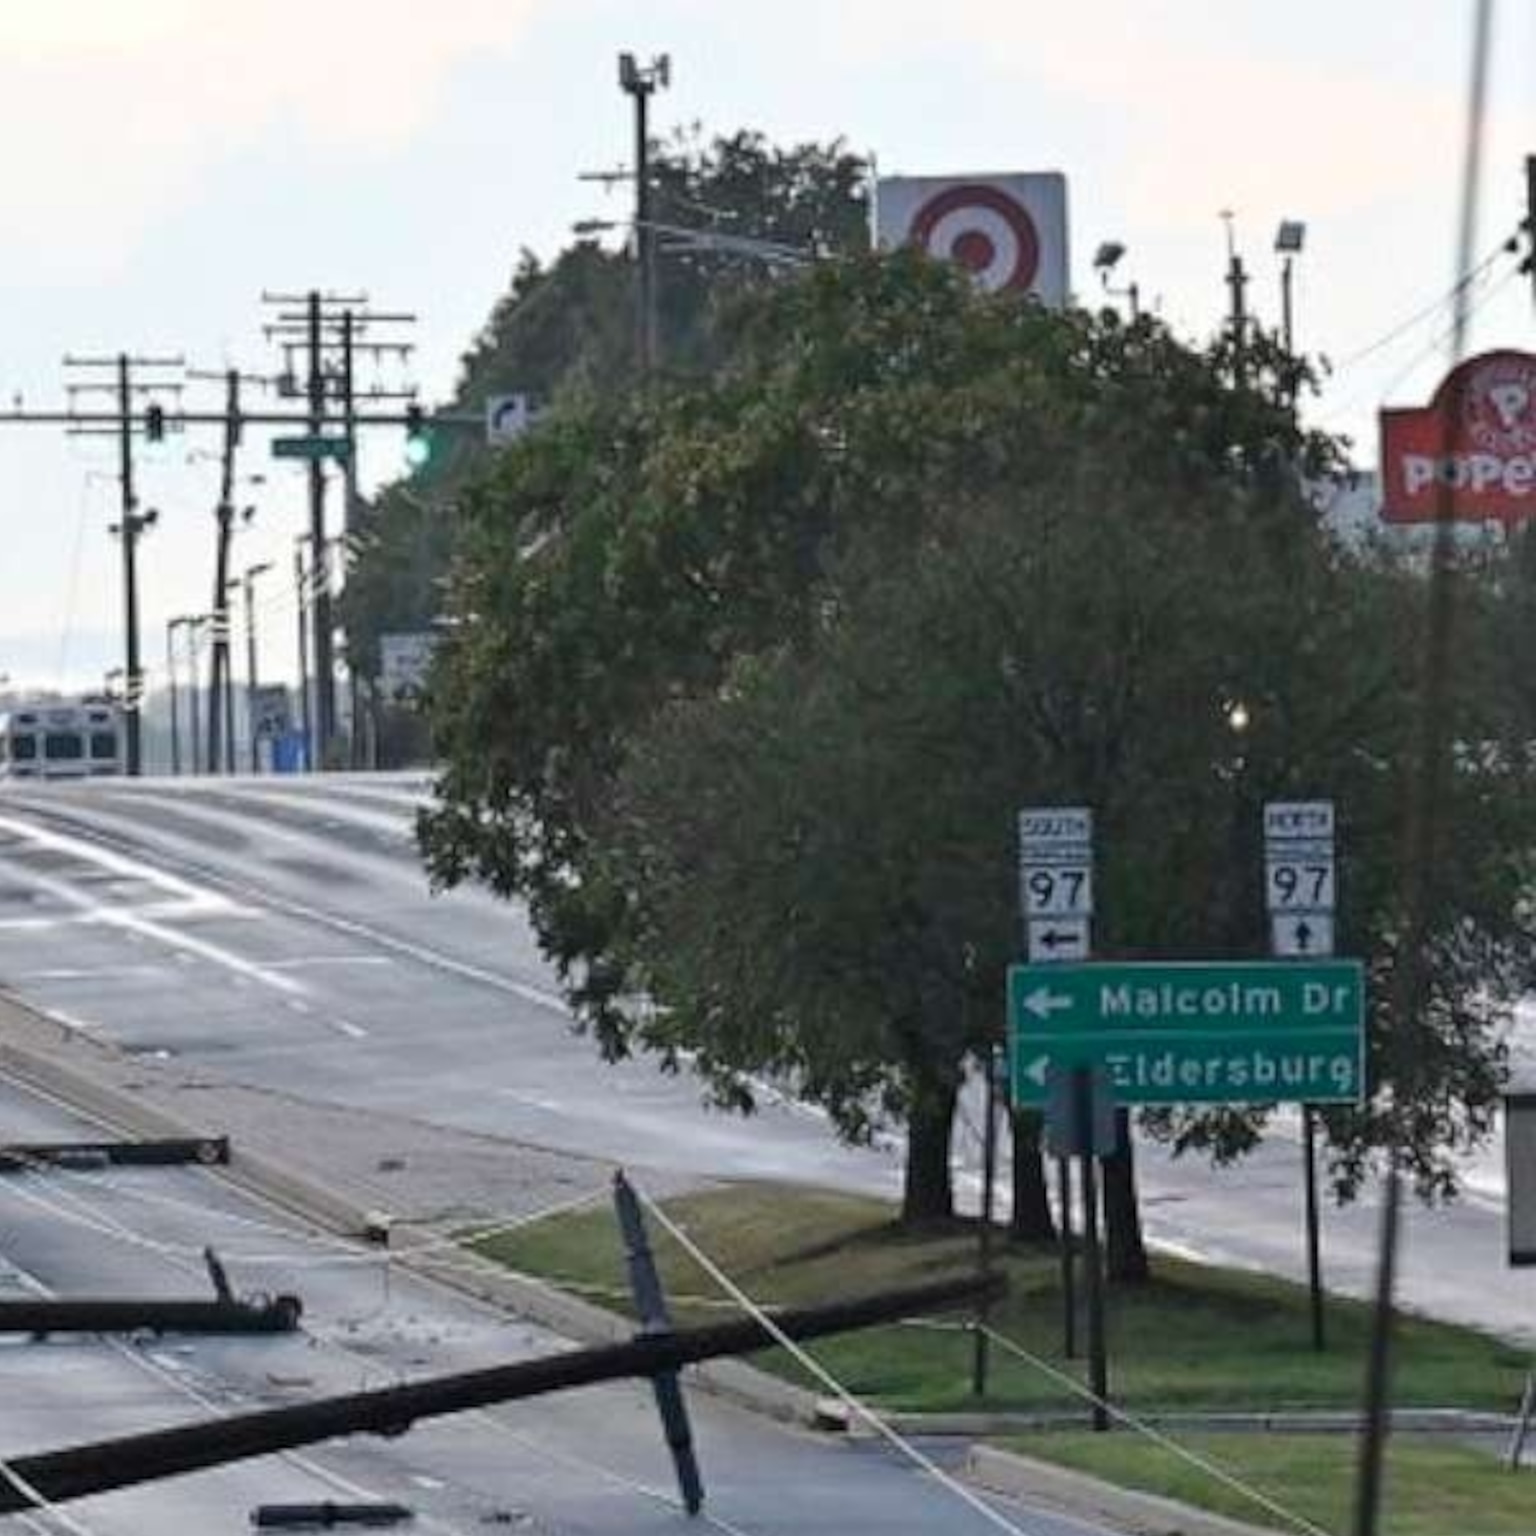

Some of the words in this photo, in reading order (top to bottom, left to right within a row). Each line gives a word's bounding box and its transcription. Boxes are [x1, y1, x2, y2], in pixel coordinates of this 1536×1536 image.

[1028, 871, 1085, 908] 97
[1273, 866, 1329, 905] 97
[1099, 982, 1282, 1016] Malcolm
[1302, 982, 1351, 1014] Dr
[1105, 1051, 1354, 1093] Eldersburg
